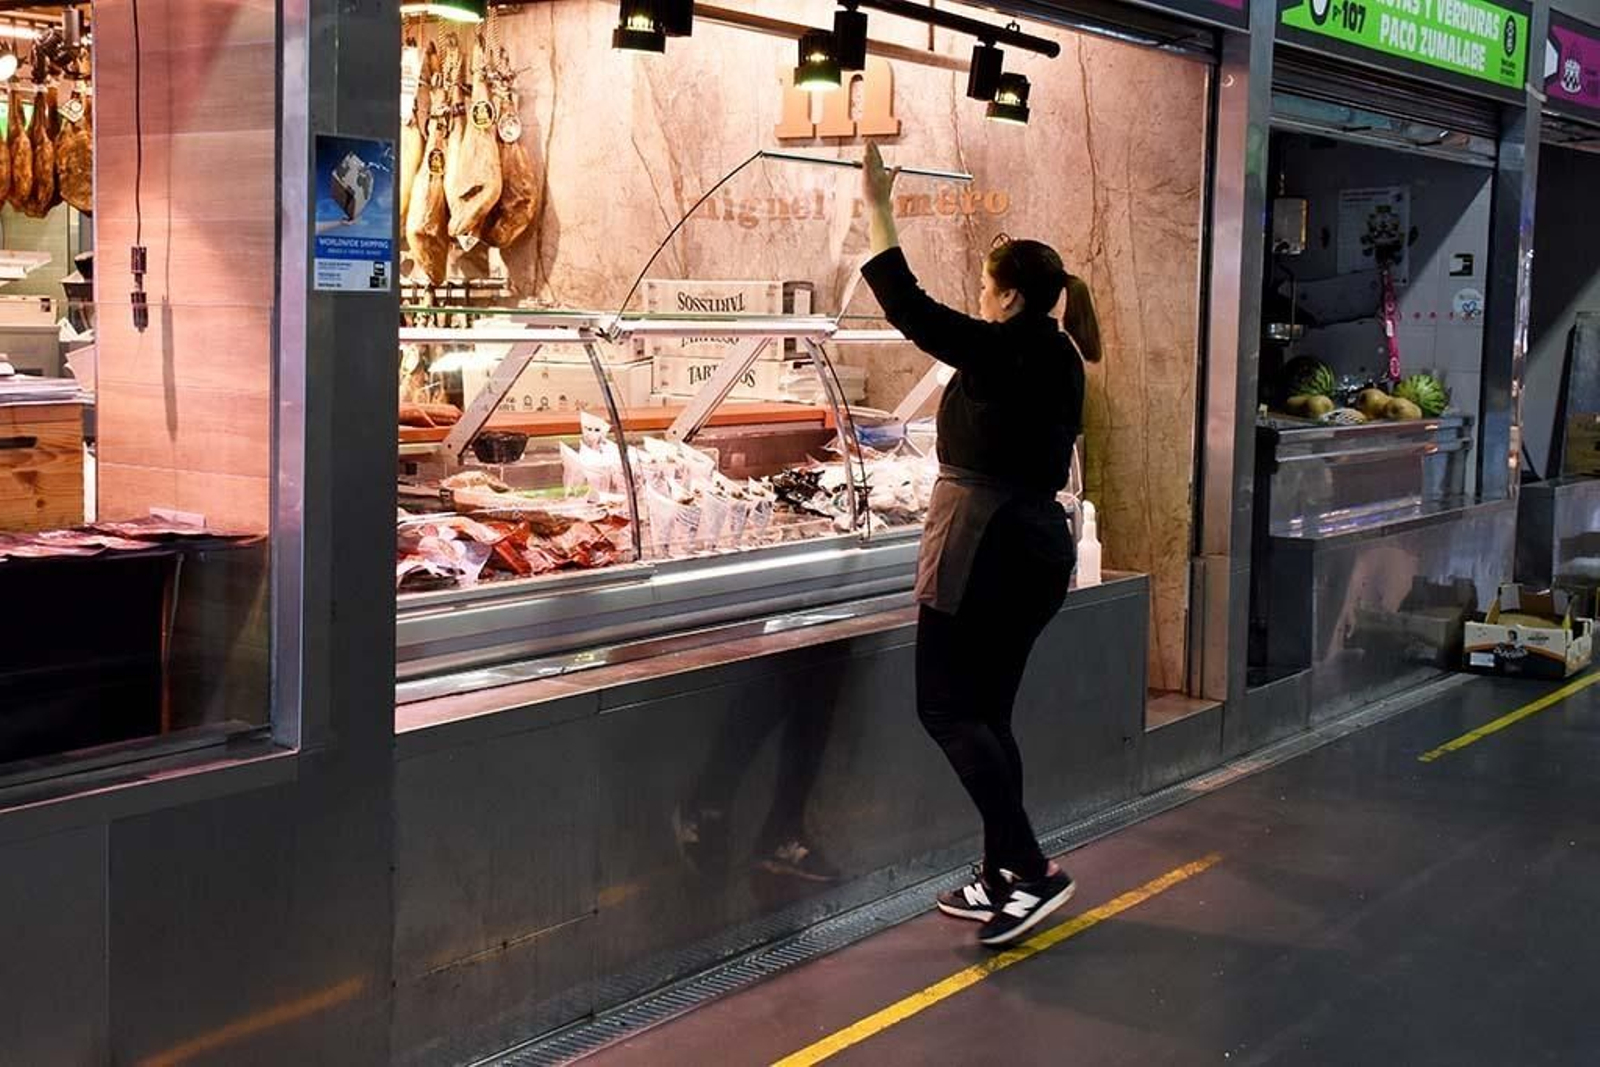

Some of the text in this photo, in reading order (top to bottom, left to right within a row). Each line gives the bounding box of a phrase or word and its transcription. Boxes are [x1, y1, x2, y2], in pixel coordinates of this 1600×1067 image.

[1379, 13, 1416, 51] PACO
[1437, 0, 1500, 41] VERDURAS
[851, 188, 1010, 218] rmero
